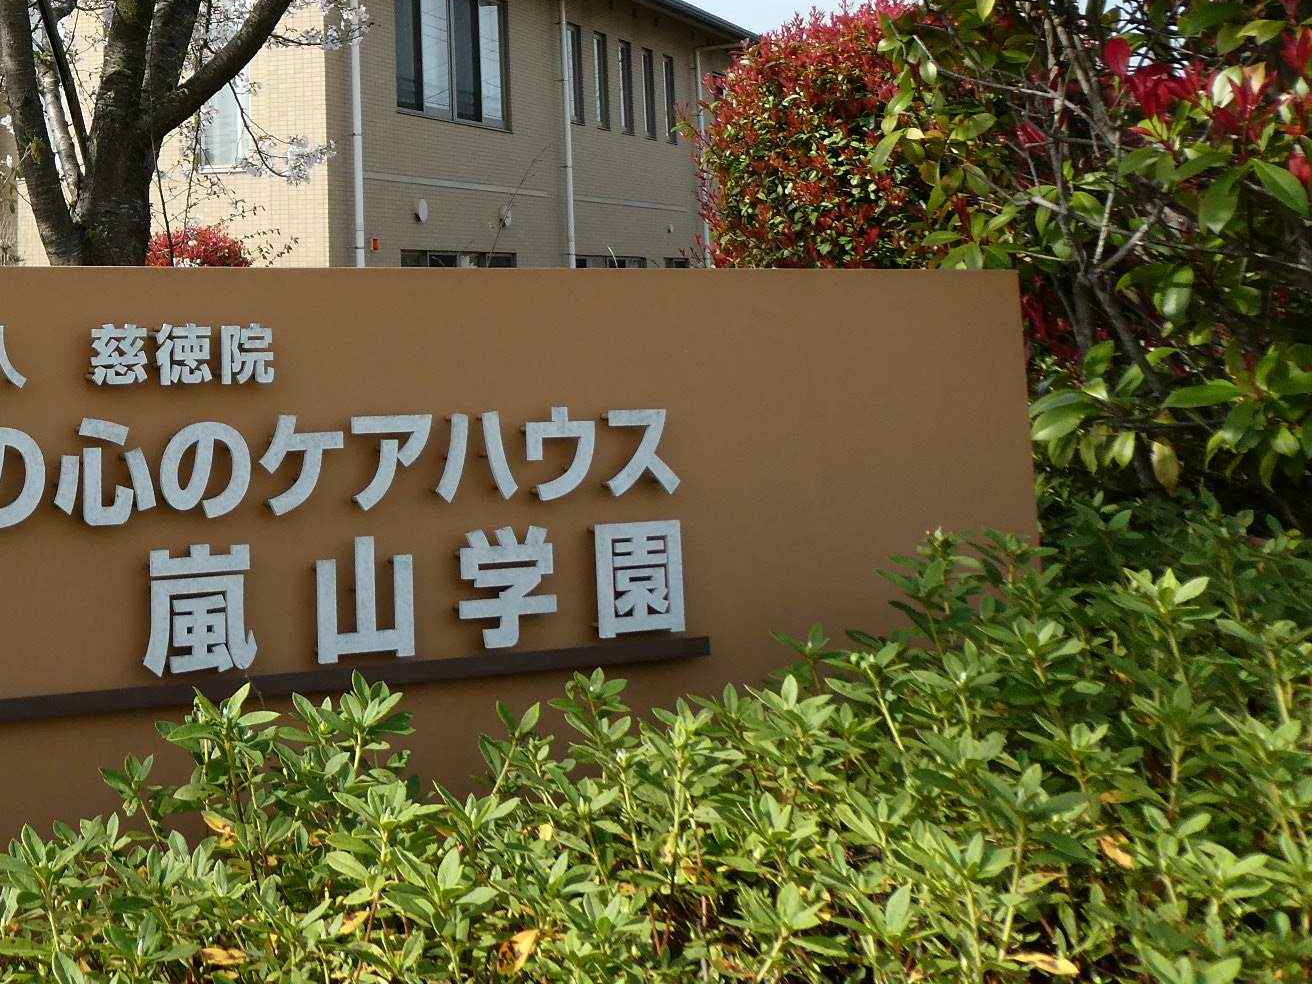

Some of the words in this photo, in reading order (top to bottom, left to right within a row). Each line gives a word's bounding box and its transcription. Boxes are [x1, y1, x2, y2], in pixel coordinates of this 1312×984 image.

[90, 322, 276, 386] 慈徳院
[143, 519, 686, 678] 嵐山学園
